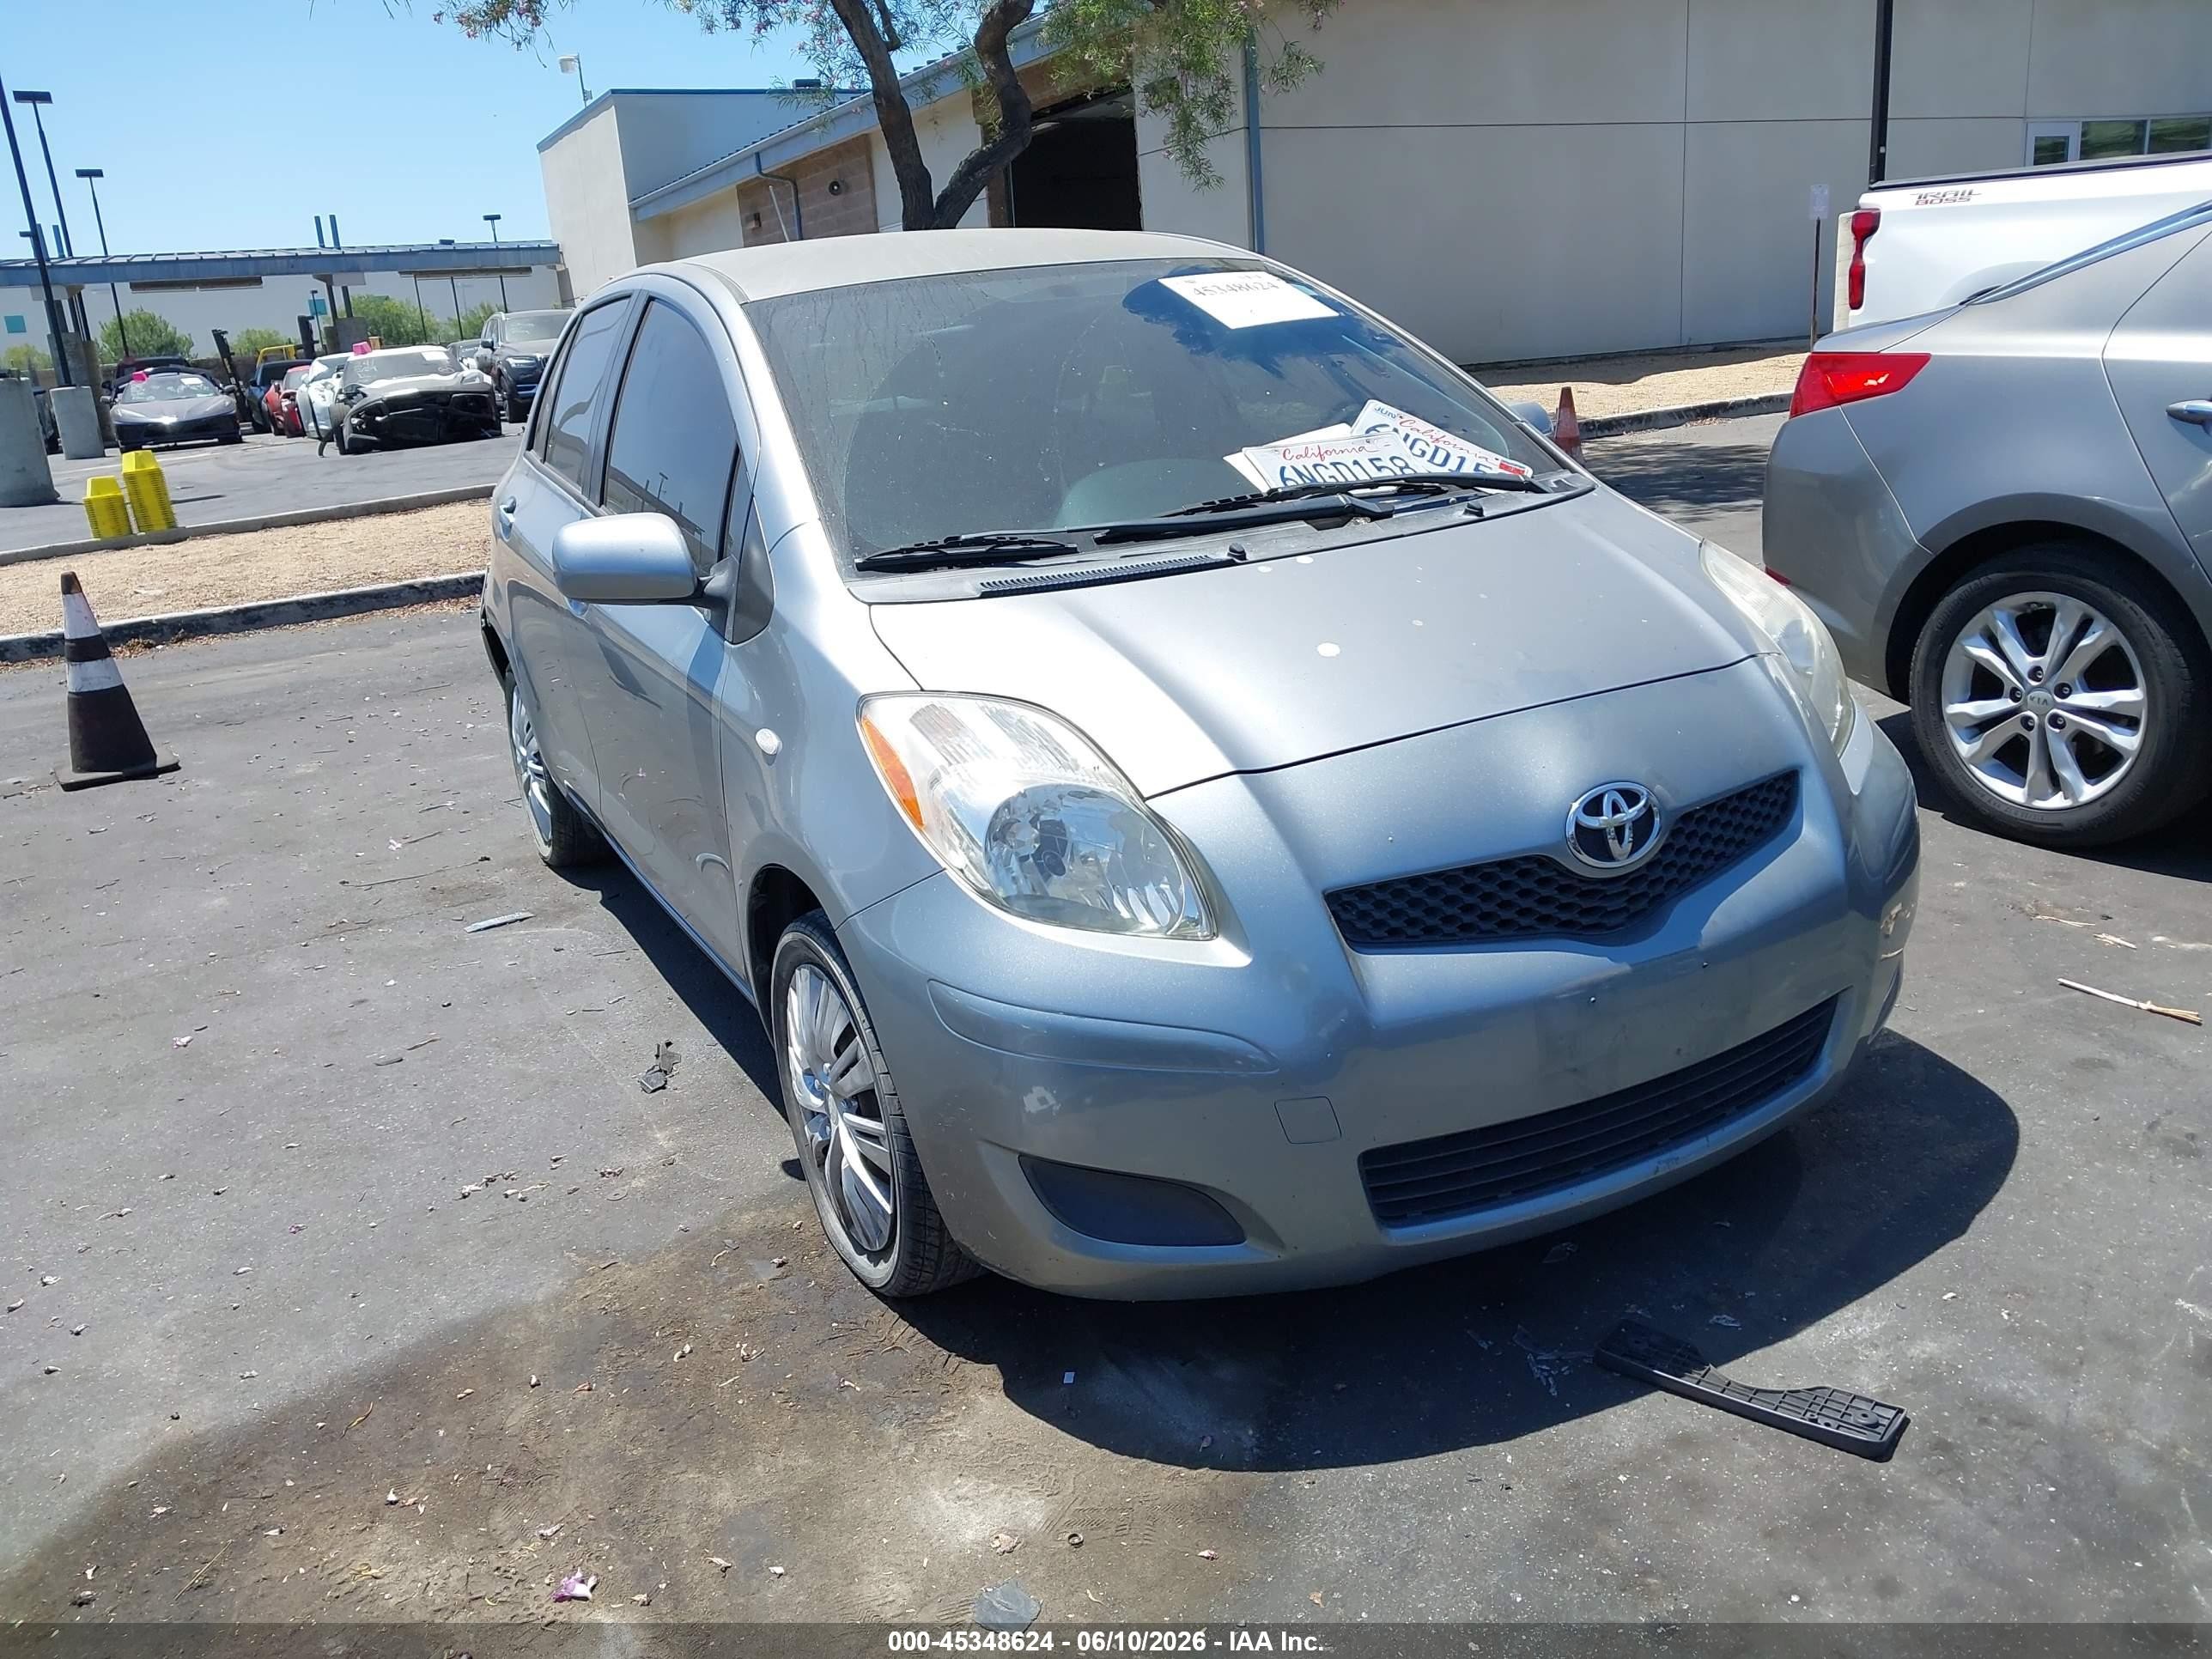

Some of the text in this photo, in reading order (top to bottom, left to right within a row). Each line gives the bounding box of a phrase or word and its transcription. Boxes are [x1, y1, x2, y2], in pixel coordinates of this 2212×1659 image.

[1909, 189, 1982, 199] TRAIL
[1915, 197, 1972, 206] BOSS
[1399, 419, 1498, 466] California
[1282, 444, 1381, 462] California
[1279, 455, 1417, 487] 6NGD158
[2029, 695, 2048, 706] KIA
